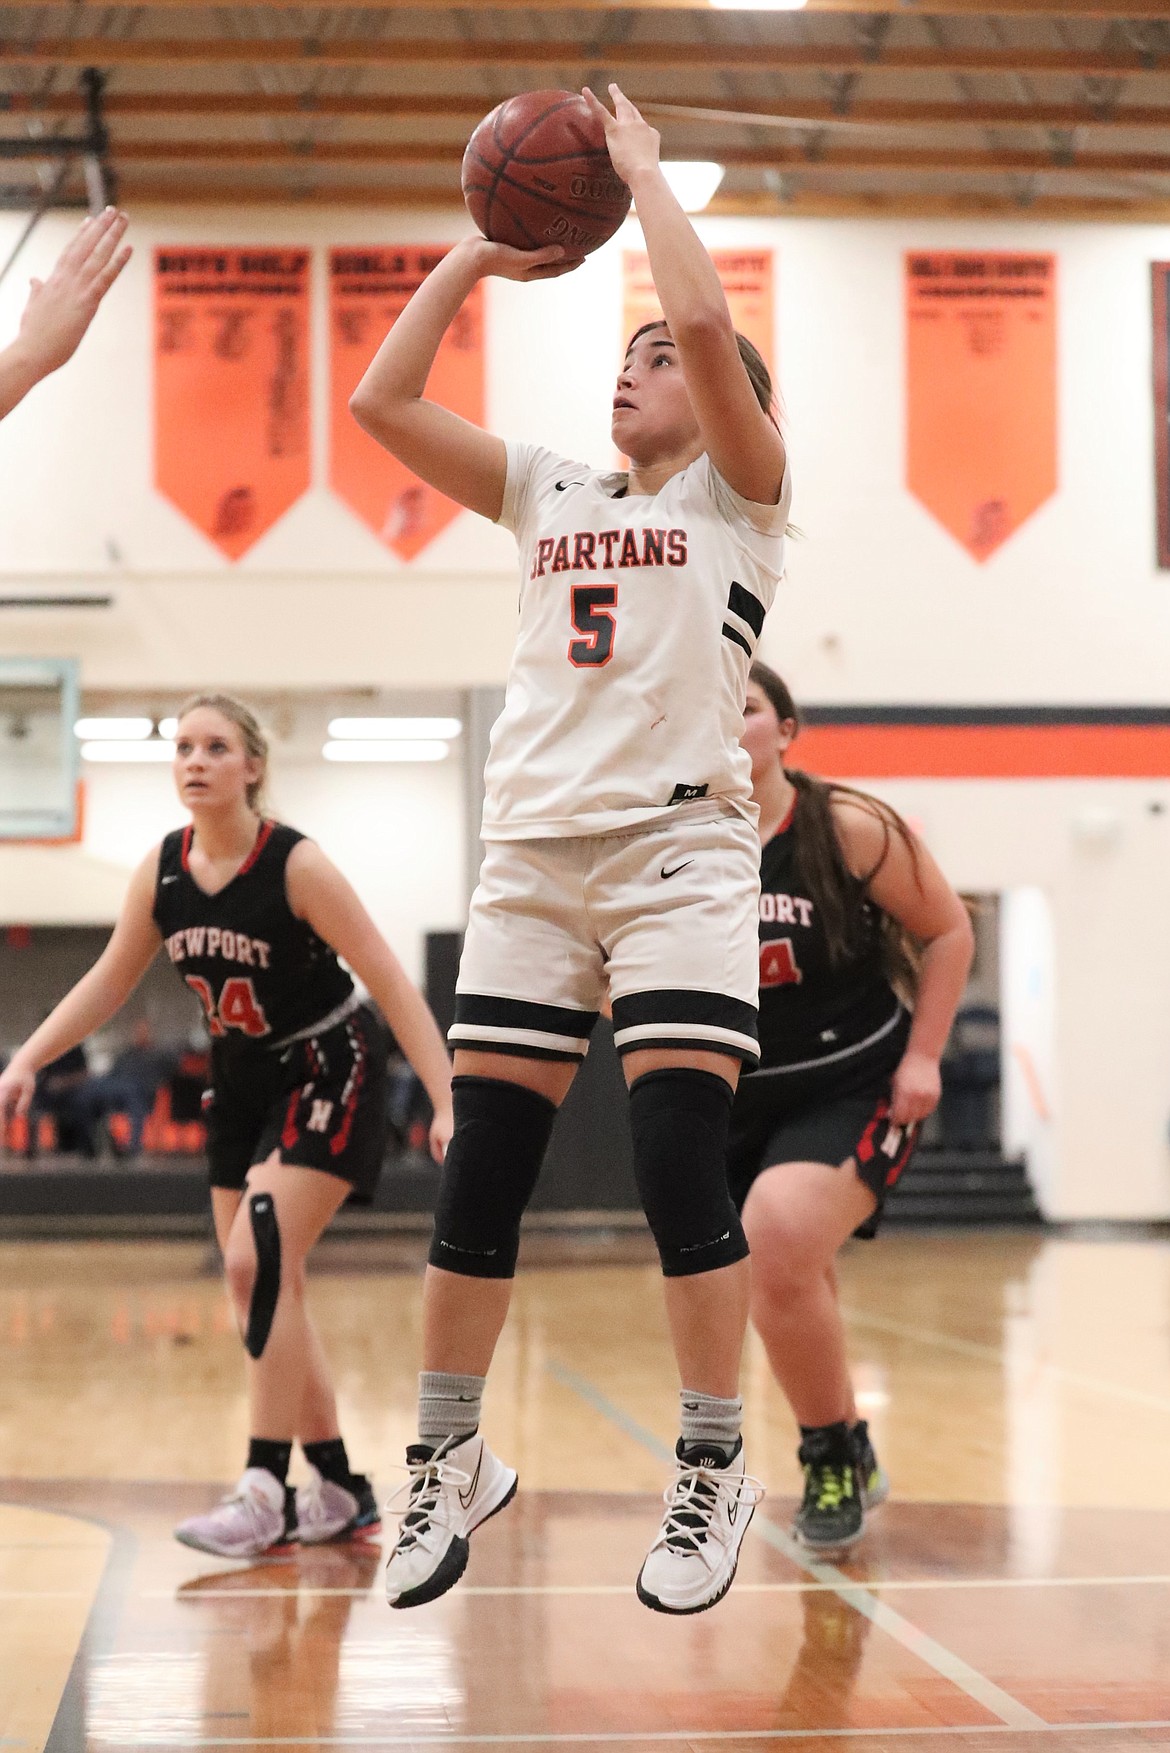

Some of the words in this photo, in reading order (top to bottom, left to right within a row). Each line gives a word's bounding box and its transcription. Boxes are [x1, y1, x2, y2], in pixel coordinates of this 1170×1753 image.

[567, 584, 619, 668] 5
[684, 789, 698, 797] M
[759, 893, 813, 927] ORT
[759, 937, 803, 989] 4
